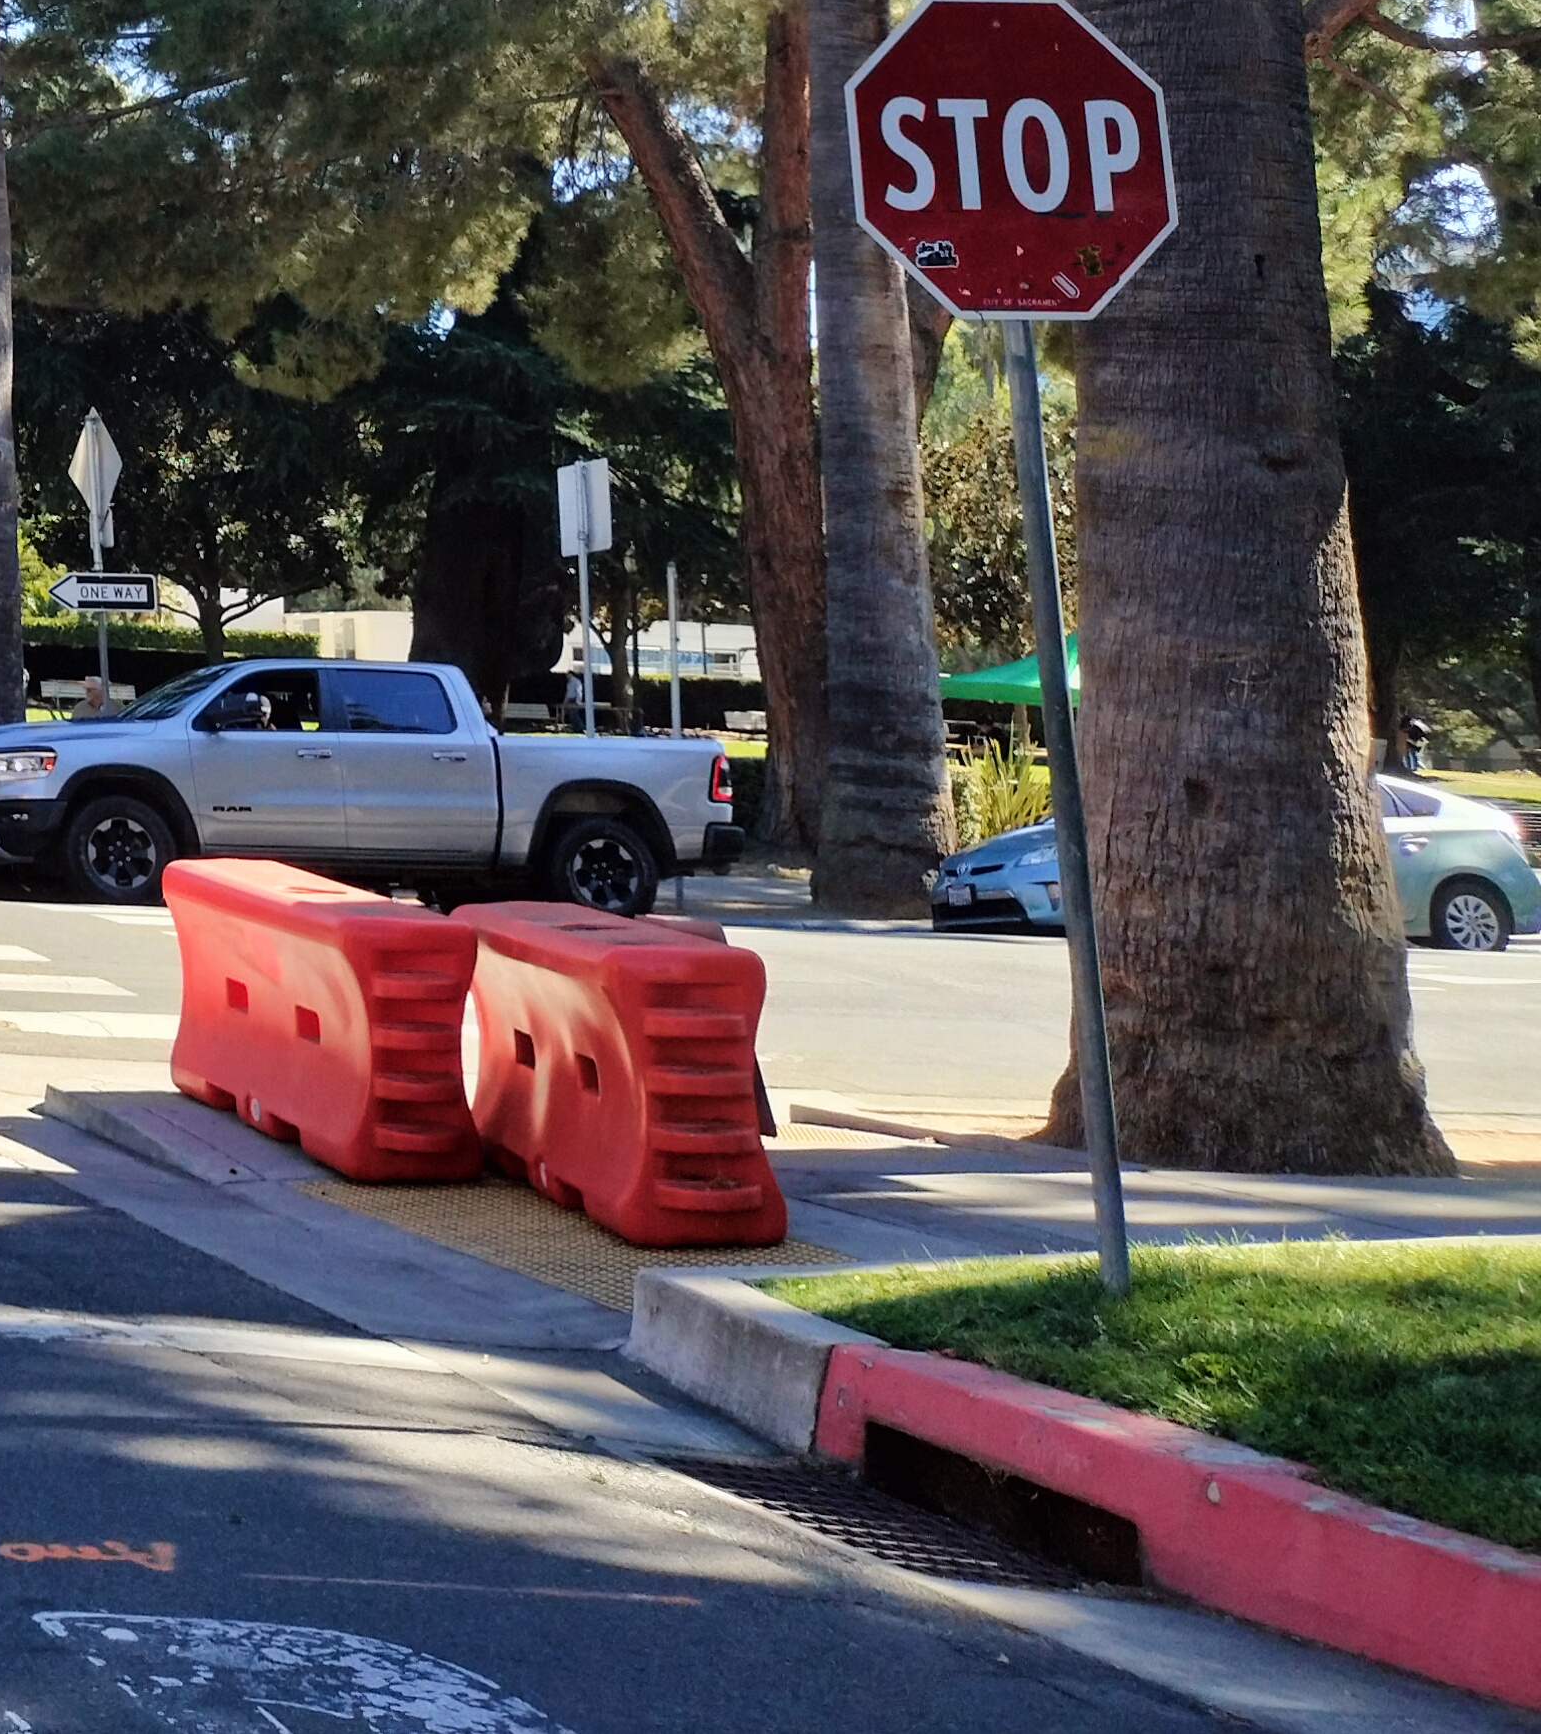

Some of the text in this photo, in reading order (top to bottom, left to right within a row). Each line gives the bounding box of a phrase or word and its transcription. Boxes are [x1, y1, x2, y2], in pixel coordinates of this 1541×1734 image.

[880, 95, 1142, 214] STOP
[1017, 297, 1061, 307] SACRAMEN
[79, 585, 144, 600] ONE WAY
